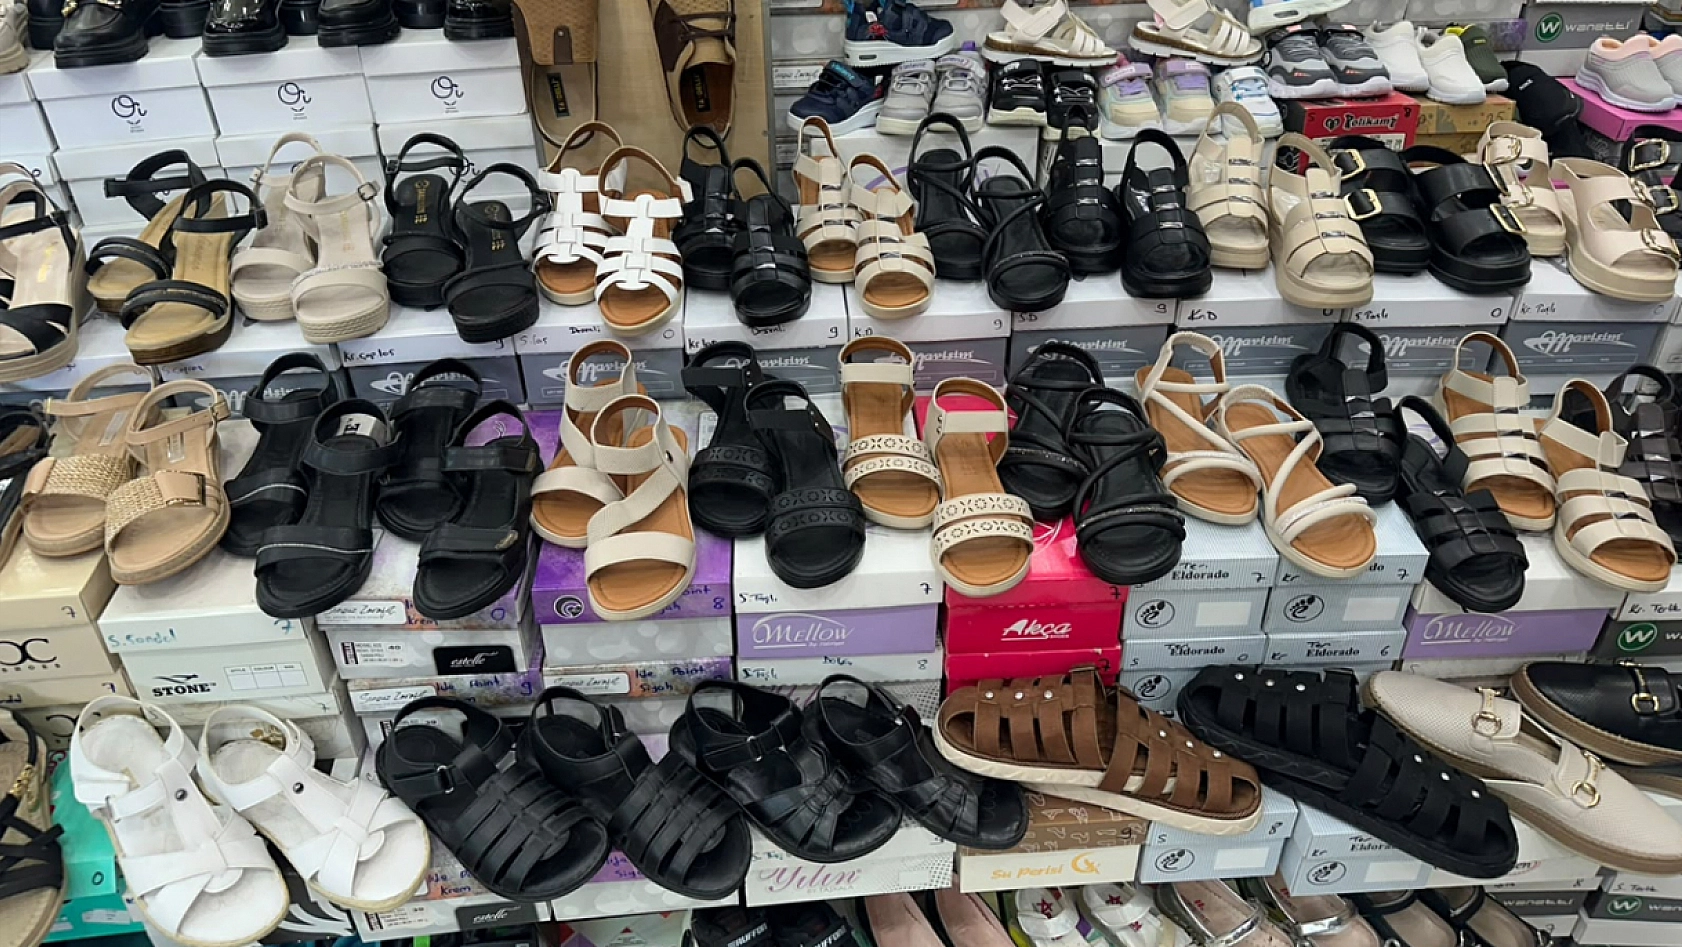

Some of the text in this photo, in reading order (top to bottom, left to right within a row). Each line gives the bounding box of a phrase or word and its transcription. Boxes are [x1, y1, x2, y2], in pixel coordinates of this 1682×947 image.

[1343, 112, 1400, 130] Polikamp
[1171, 570, 1230, 581] Eldorado
[1002, 619, 1072, 638] Akça
[1170, 646, 1226, 657] Eldorado
[1306, 647, 1360, 657] Eldorado
[152, 682, 212, 698] STONE
[1350, 843, 1396, 852] Eldora
[991, 869, 1012, 880] Su
